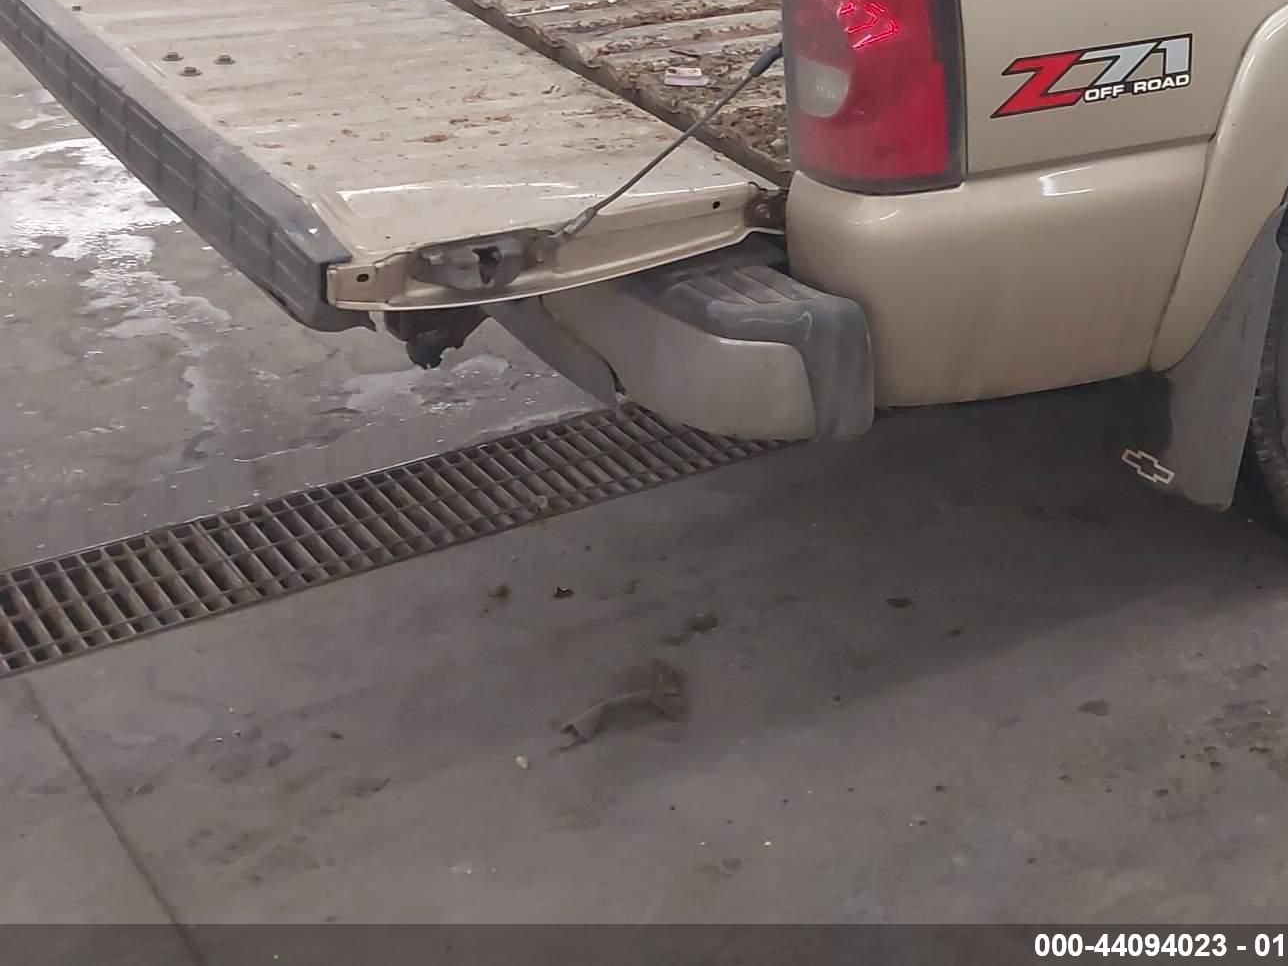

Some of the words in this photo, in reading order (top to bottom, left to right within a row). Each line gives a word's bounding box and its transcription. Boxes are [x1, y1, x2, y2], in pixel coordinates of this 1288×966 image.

[990, 33, 1192, 118] Z71
[1084, 84, 1125, 101] OFF
[1133, 74, 1190, 94] ROAD
